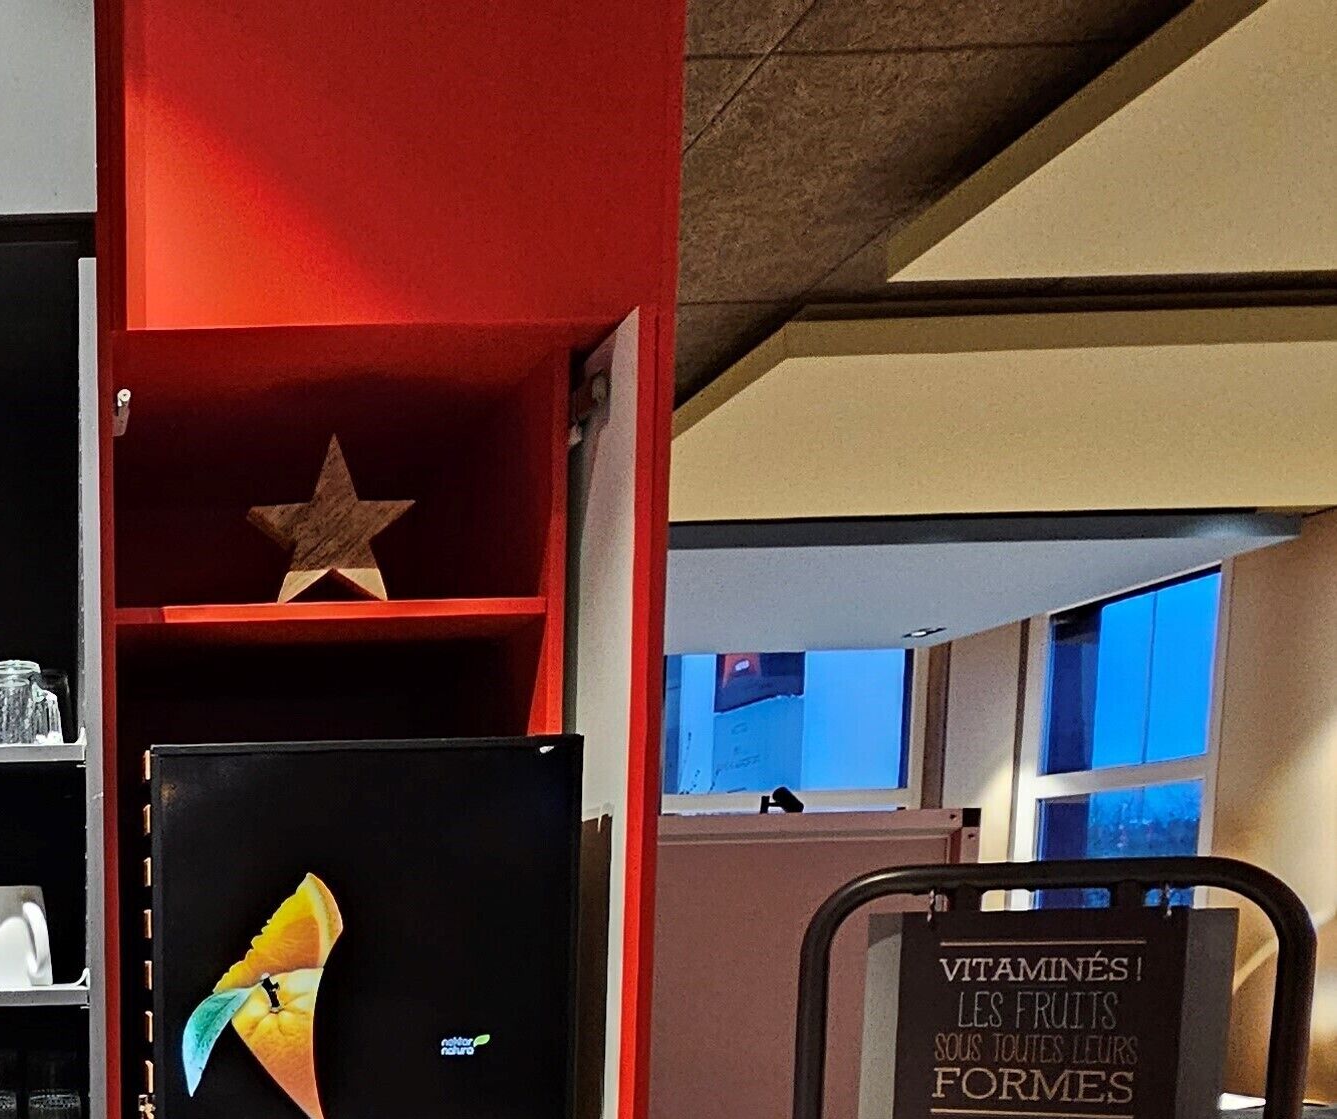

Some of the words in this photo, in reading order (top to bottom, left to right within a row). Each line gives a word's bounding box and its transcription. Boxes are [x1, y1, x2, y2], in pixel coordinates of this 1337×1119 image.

[957, 991, 1004, 1028] LES
[1015, 991, 1118, 1030] FRUITS
[934, 1033, 983, 1062] SOUS
[993, 1033, 1063, 1064] TOUTES
[1072, 1035, 1138, 1066] LEURS
[931, 1067, 1134, 1104] FORMES
